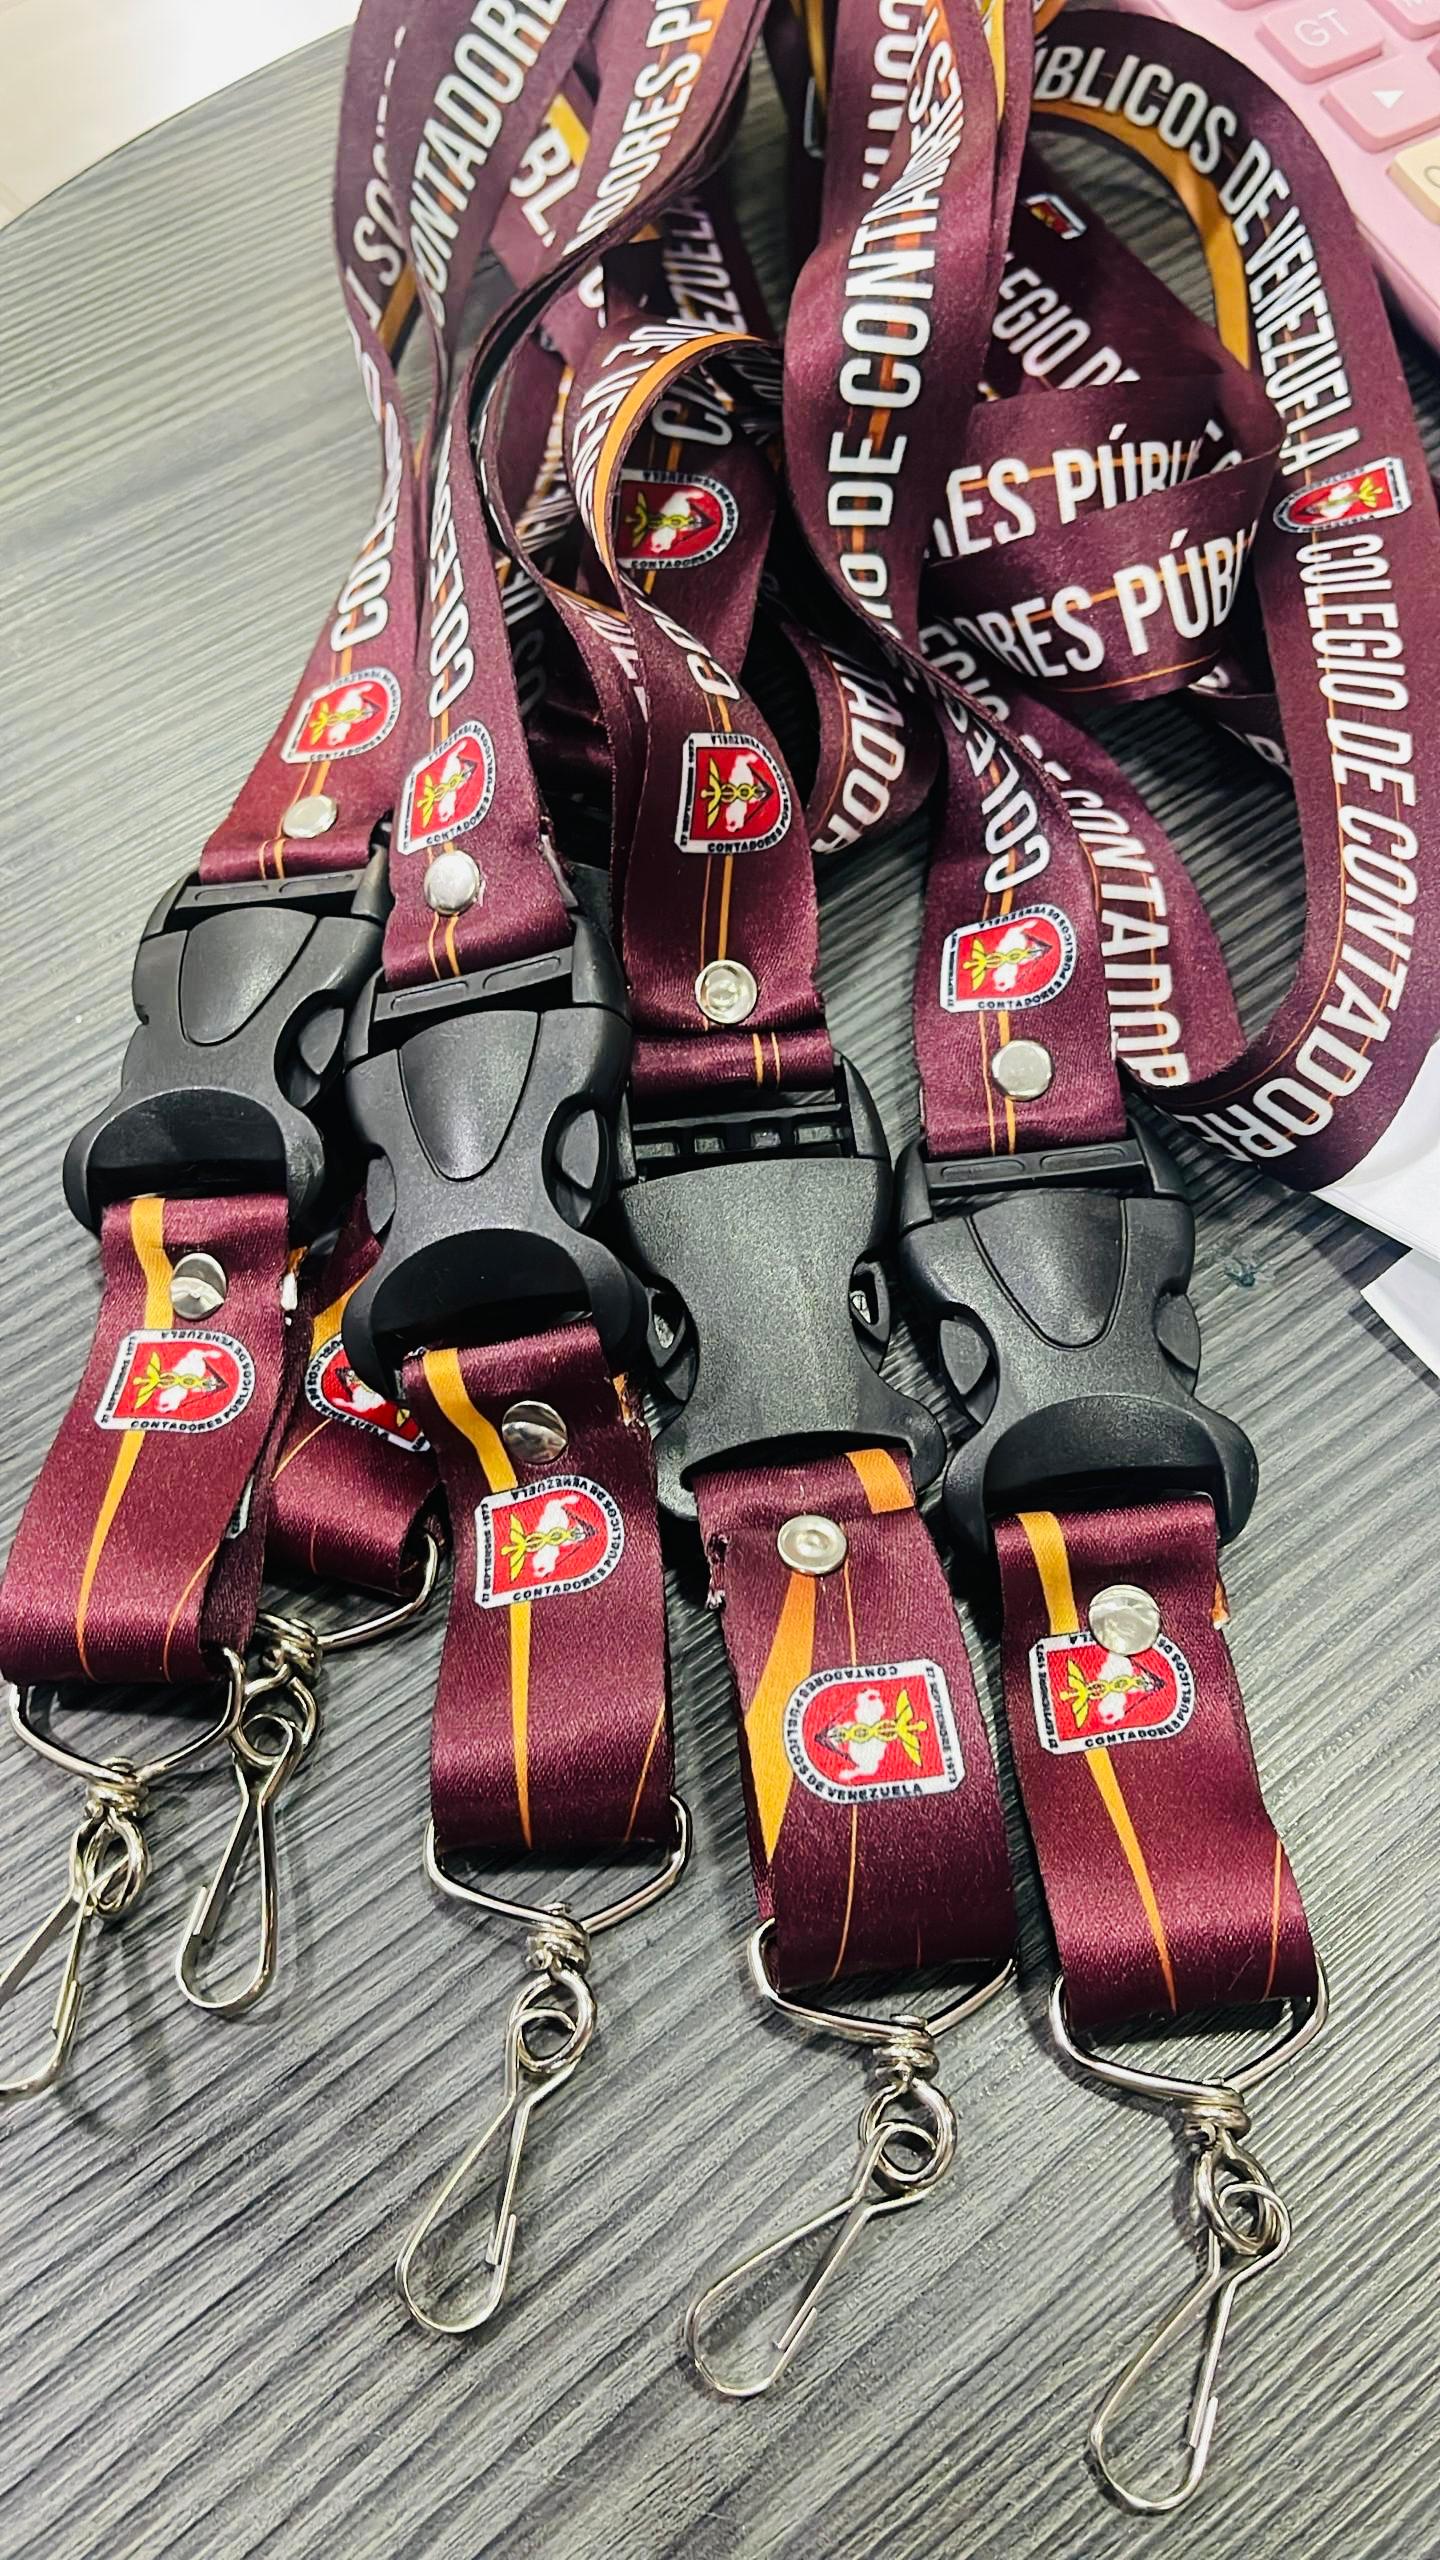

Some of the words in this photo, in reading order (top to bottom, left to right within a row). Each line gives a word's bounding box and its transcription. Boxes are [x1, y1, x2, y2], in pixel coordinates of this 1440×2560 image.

[646, 0, 713, 47] P
[1294, 8, 1349, 46] GT
[1034, 37, 1238, 176] BLICOS
[1218, 139, 1291, 246] DE
[992, 252, 1091, 377] EGIO
[1246, 206, 1361, 477] VENEZUELA
[828, 431, 907, 526] DE
[1296, 534, 1410, 712] COLEGIO
[1326, 718, 1416, 807] DE
[130, 1417, 223, 1432] CONTADORES
[512, 1568, 607, 1601] CONTADORES
[798, 1665, 899, 1698] CONTADORES
[1084, 1719, 1181, 1748] CONTADORES
[827, 1782, 924, 1801] VENEZUELA
